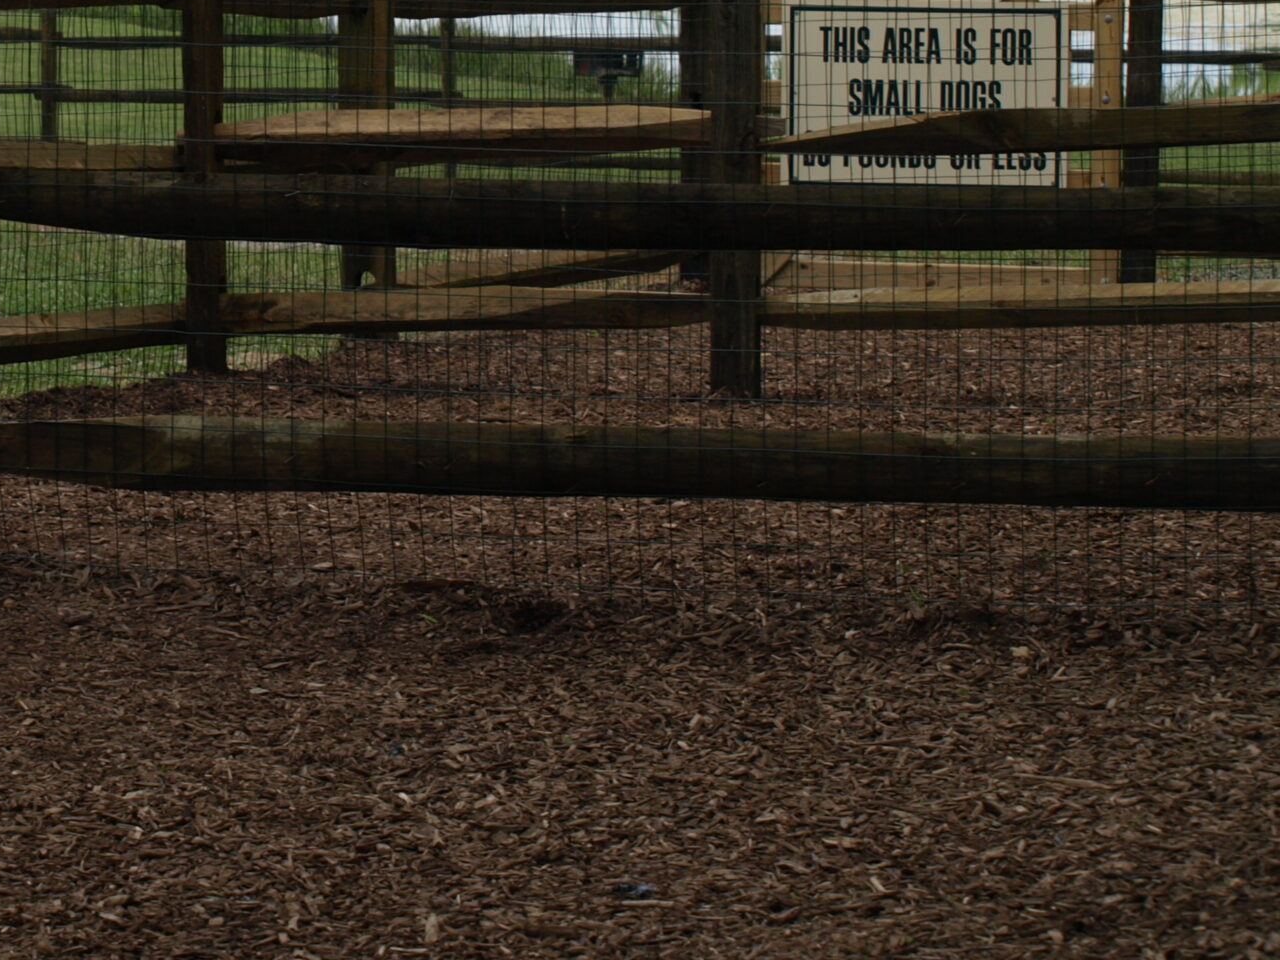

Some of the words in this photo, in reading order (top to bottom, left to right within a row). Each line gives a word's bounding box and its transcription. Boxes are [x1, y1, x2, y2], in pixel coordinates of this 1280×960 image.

[819, 26, 870, 63] THIS
[882, 27, 941, 64] AREA
[955, 28, 977, 65] IS
[990, 28, 1032, 66] FOR
[848, 78, 925, 116] SMALL
[940, 80, 1001, 112] DOGS
